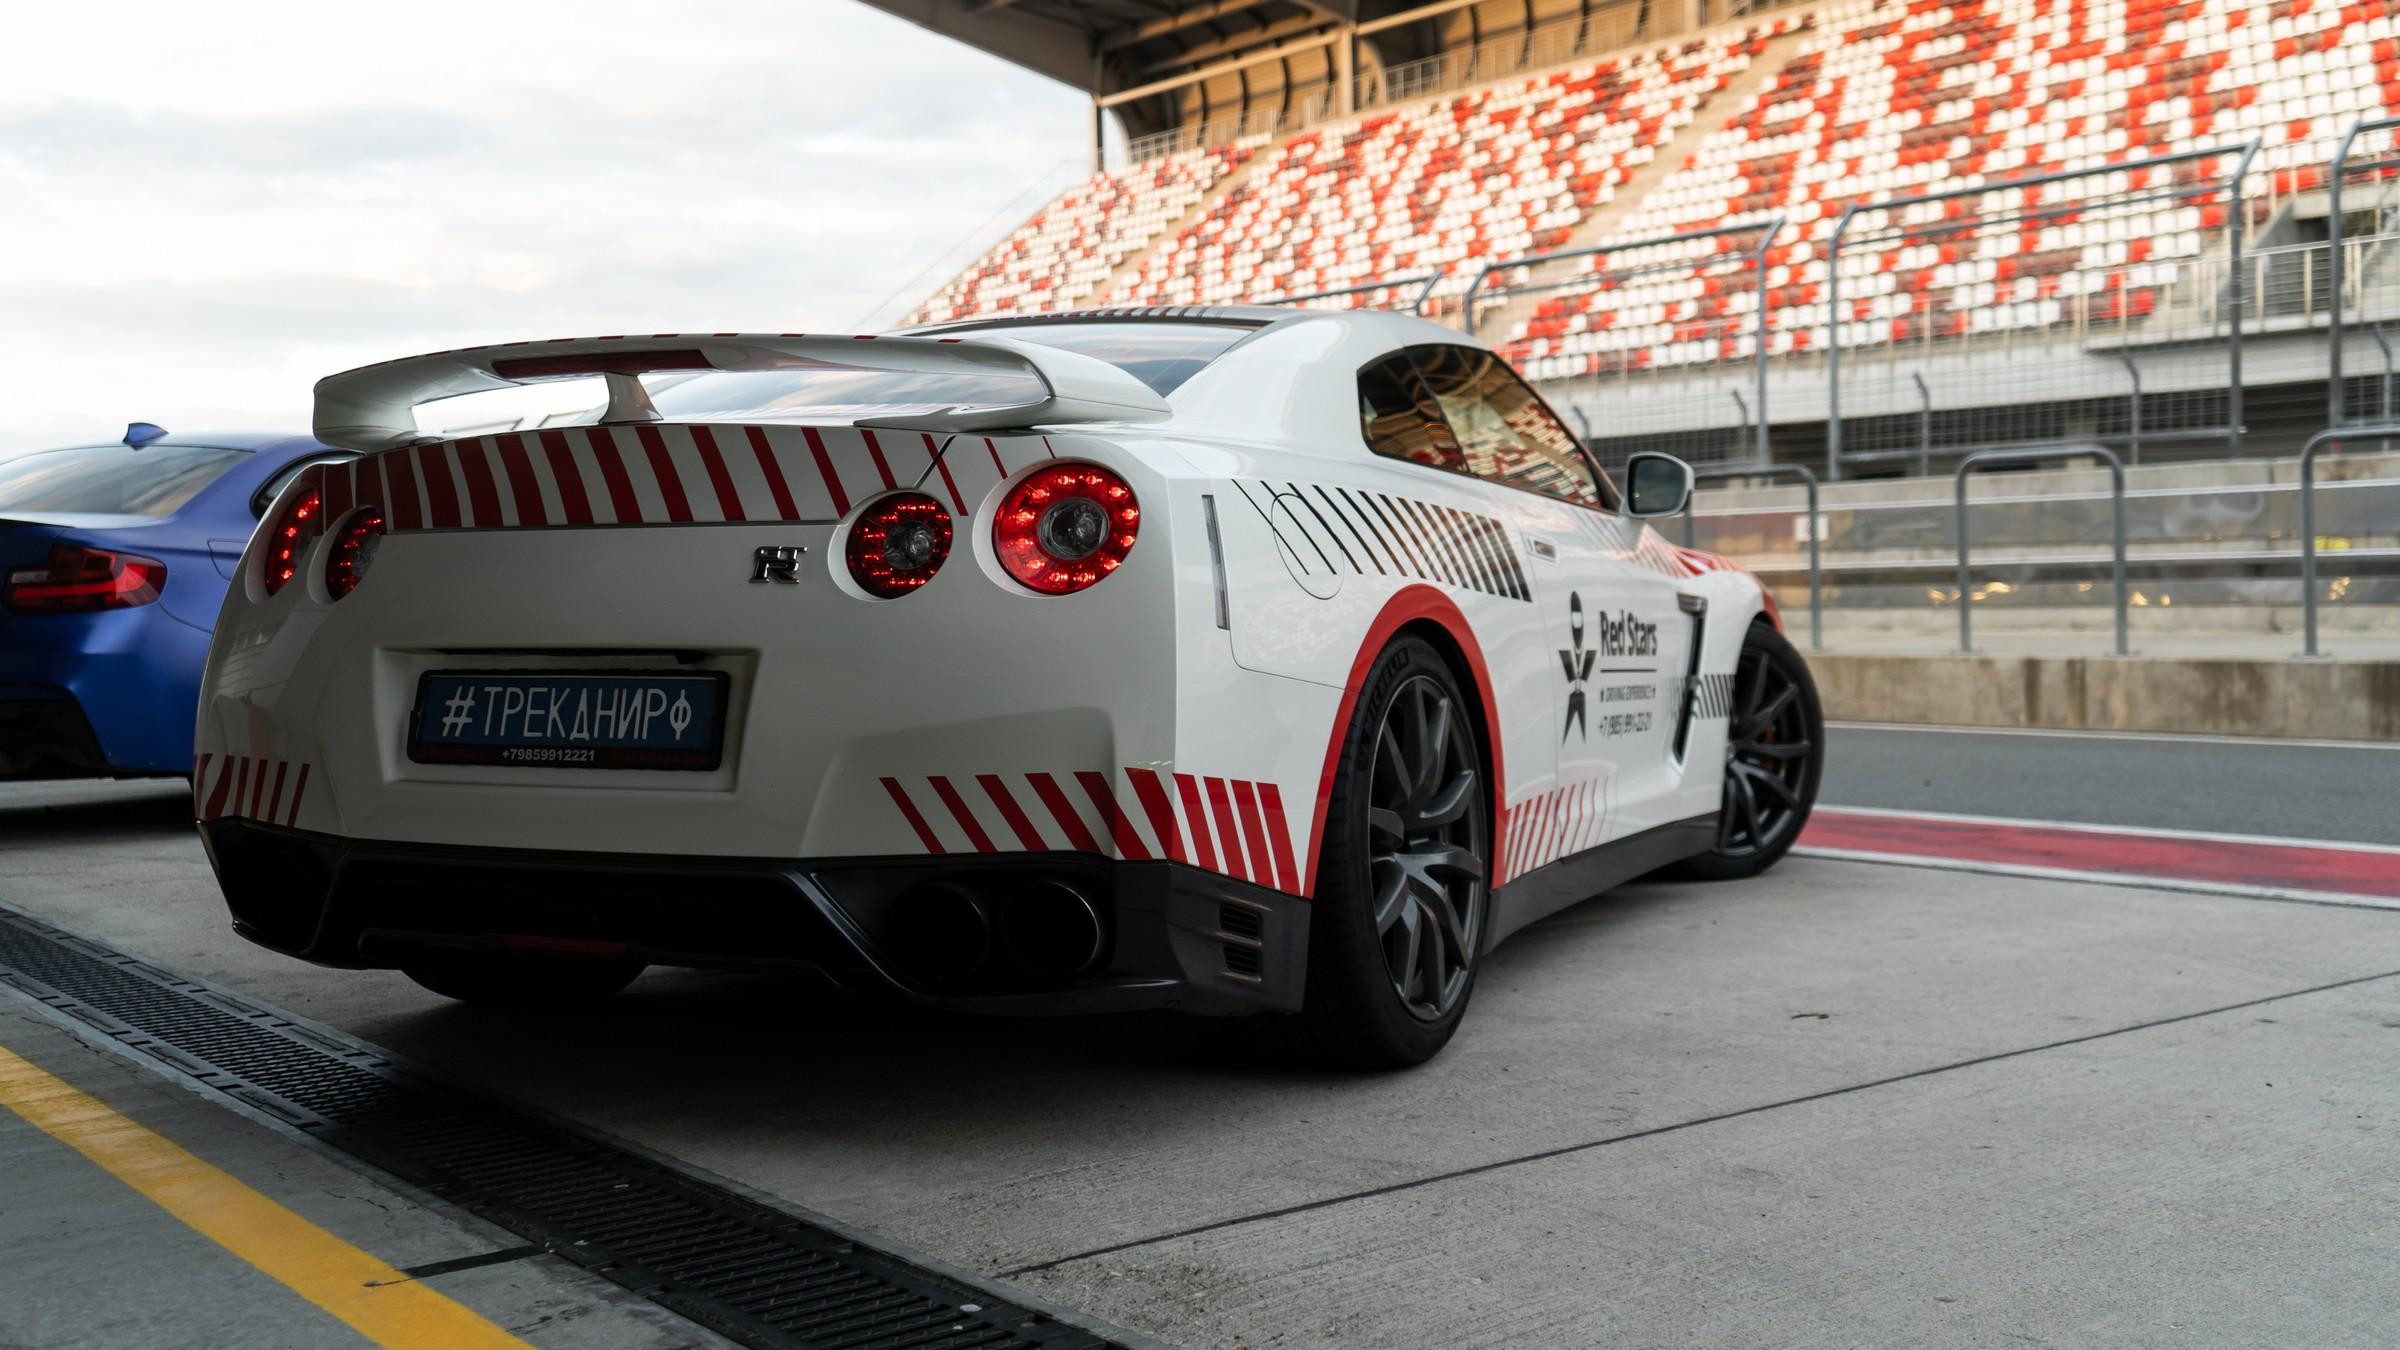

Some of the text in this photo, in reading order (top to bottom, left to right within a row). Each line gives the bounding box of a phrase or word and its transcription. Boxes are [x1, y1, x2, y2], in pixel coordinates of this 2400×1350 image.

[1600, 610, 1658, 657] Red Stars
[442, 685, 692, 741] #ТРЕКДНИРФ
[502, 748, 596, 762] +79859912221
